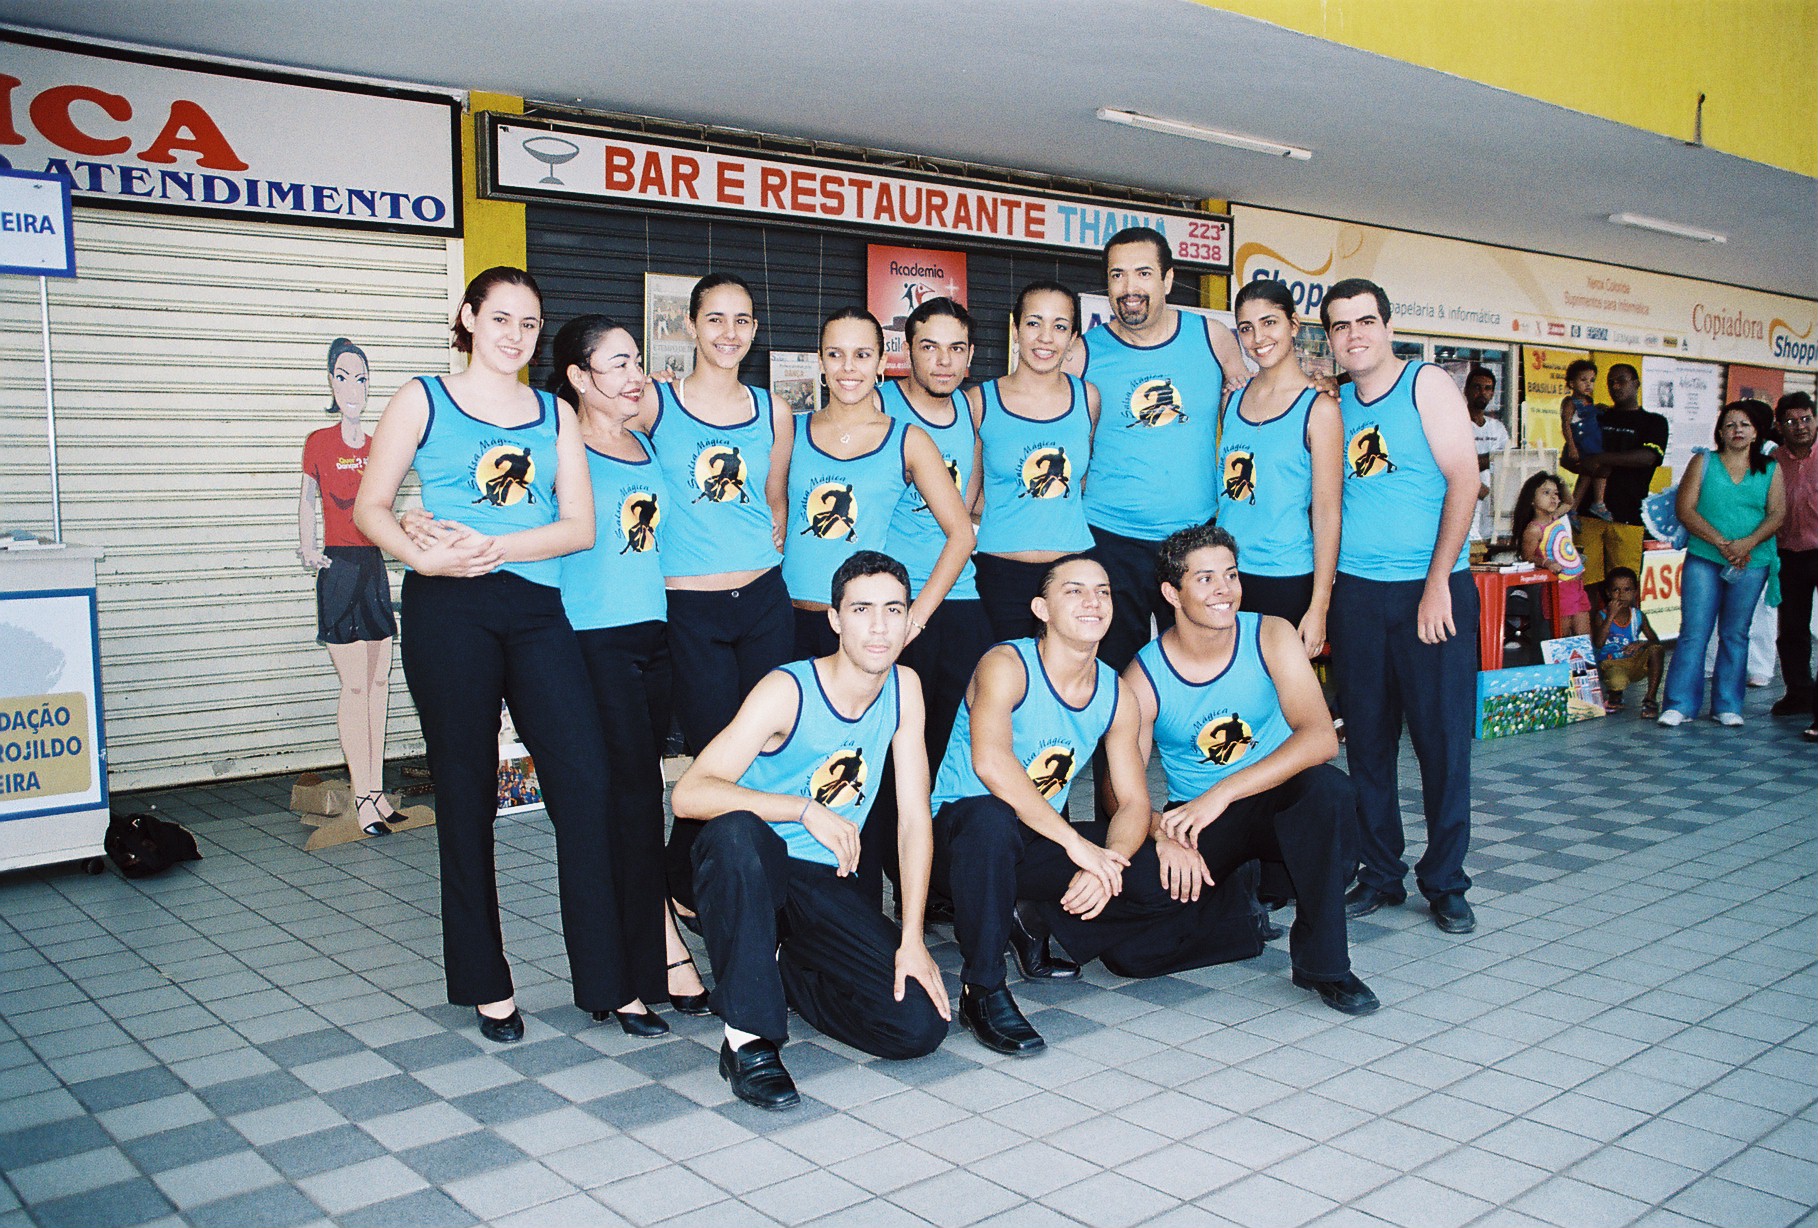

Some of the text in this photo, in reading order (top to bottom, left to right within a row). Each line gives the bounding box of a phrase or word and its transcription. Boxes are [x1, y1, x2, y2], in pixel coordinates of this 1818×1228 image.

[44, 157, 446, 222] ATENDIMENTO
[605, 145, 700, 199] BAR
[716, 161, 745, 205] E
[760, 166, 1046, 239] RESTAURANTE
[1, 211, 56, 235] EIRA
[1178, 241, 1222, 261] 8338
[890, 260, 945, 279] Academia
[1389, 301, 1435, 318] papelaria
[1449, 307, 1501, 325] informática
[1692, 303, 1764, 340] Copiadora
[886, 336, 905, 353] stil
[480, 437, 520, 455] Mág
[688, 438, 730, 490] Salsa Mágica
[0, 703, 70, 734] DAÇÃO
